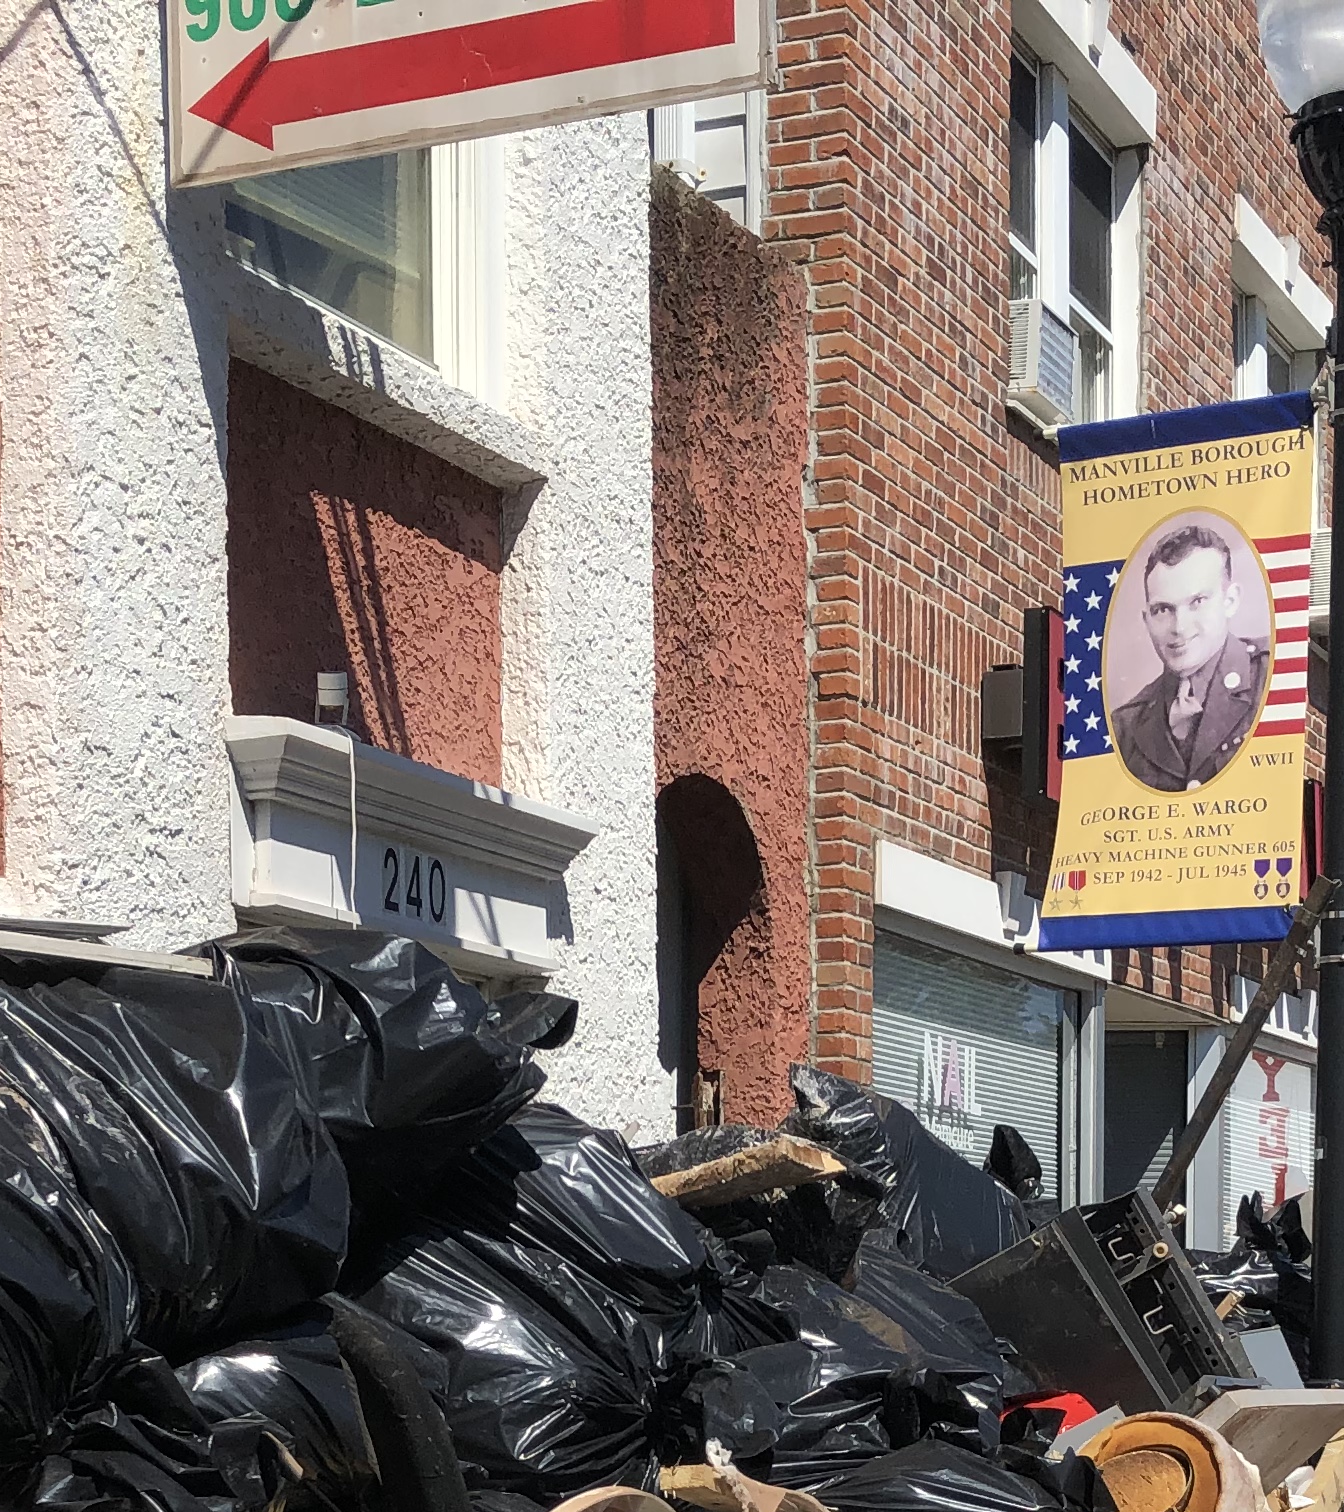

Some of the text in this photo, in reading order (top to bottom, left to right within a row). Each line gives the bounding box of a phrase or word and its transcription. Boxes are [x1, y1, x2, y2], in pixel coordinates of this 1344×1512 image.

[1068, 435, 1307, 484] MANVILLE BOROUGH
[1082, 461, 1291, 507] HOMETOWN HERO
[1249, 752, 1295, 768] WWII
[1079, 797, 1269, 826] GEORGE E. WARGO
[1103, 824, 1236, 844] SGT. U.S. ARMY
[1054, 840, 1296, 869] HEAVY MACHINE GUNNER 605
[383, 847, 447, 924] 240
[1092, 871, 1125, 885] SEP
[1130, 868, 1163, 883] 1942
[1175, 866, 1210, 884] JUL
[1214, 863, 1248, 878] 1945
